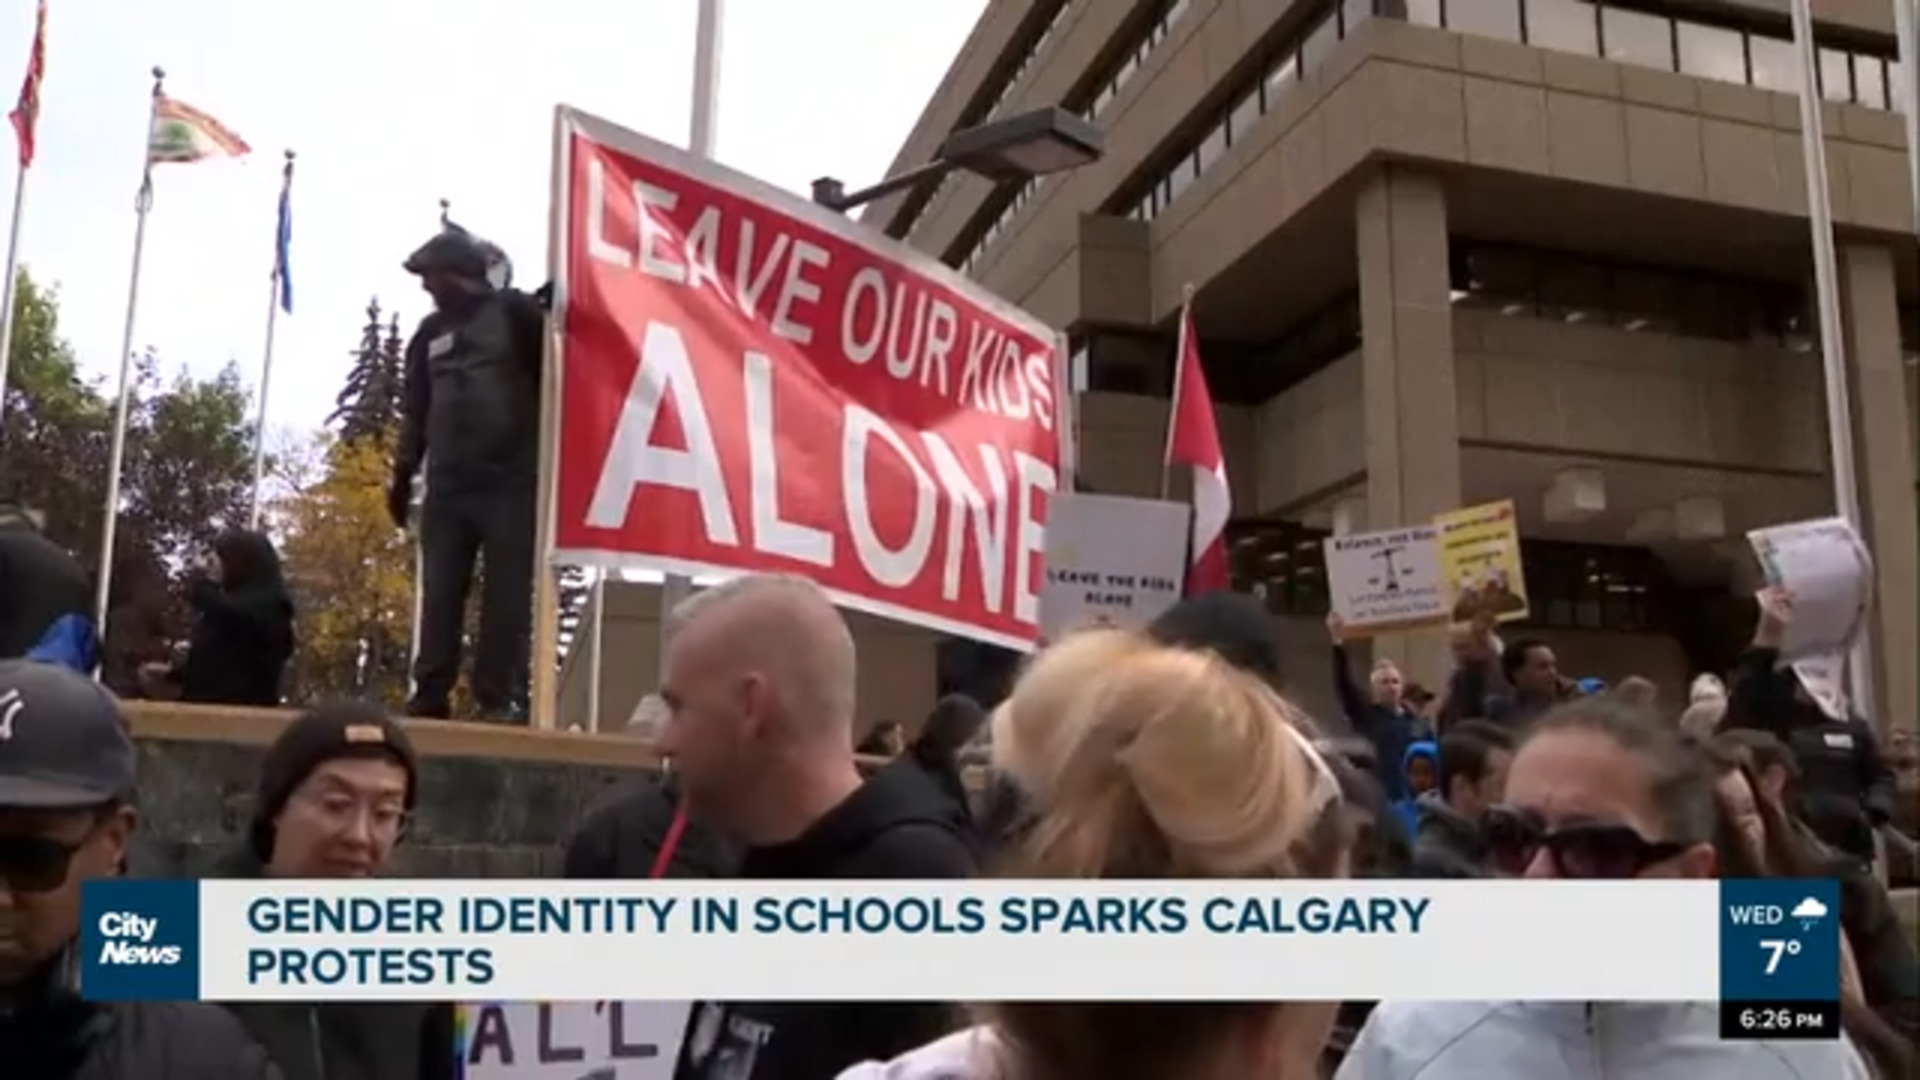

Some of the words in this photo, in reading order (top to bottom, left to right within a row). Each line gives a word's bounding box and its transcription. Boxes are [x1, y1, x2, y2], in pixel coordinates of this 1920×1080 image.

[588, 159, 831, 345] LEAVE
[842, 267, 958, 396] OUR
[958, 321, 1053, 431] KIDS
[583, 321, 1057, 624] ALONE
[1047, 568, 1099, 586] LEAVE
[1106, 575, 1134, 588] THE
